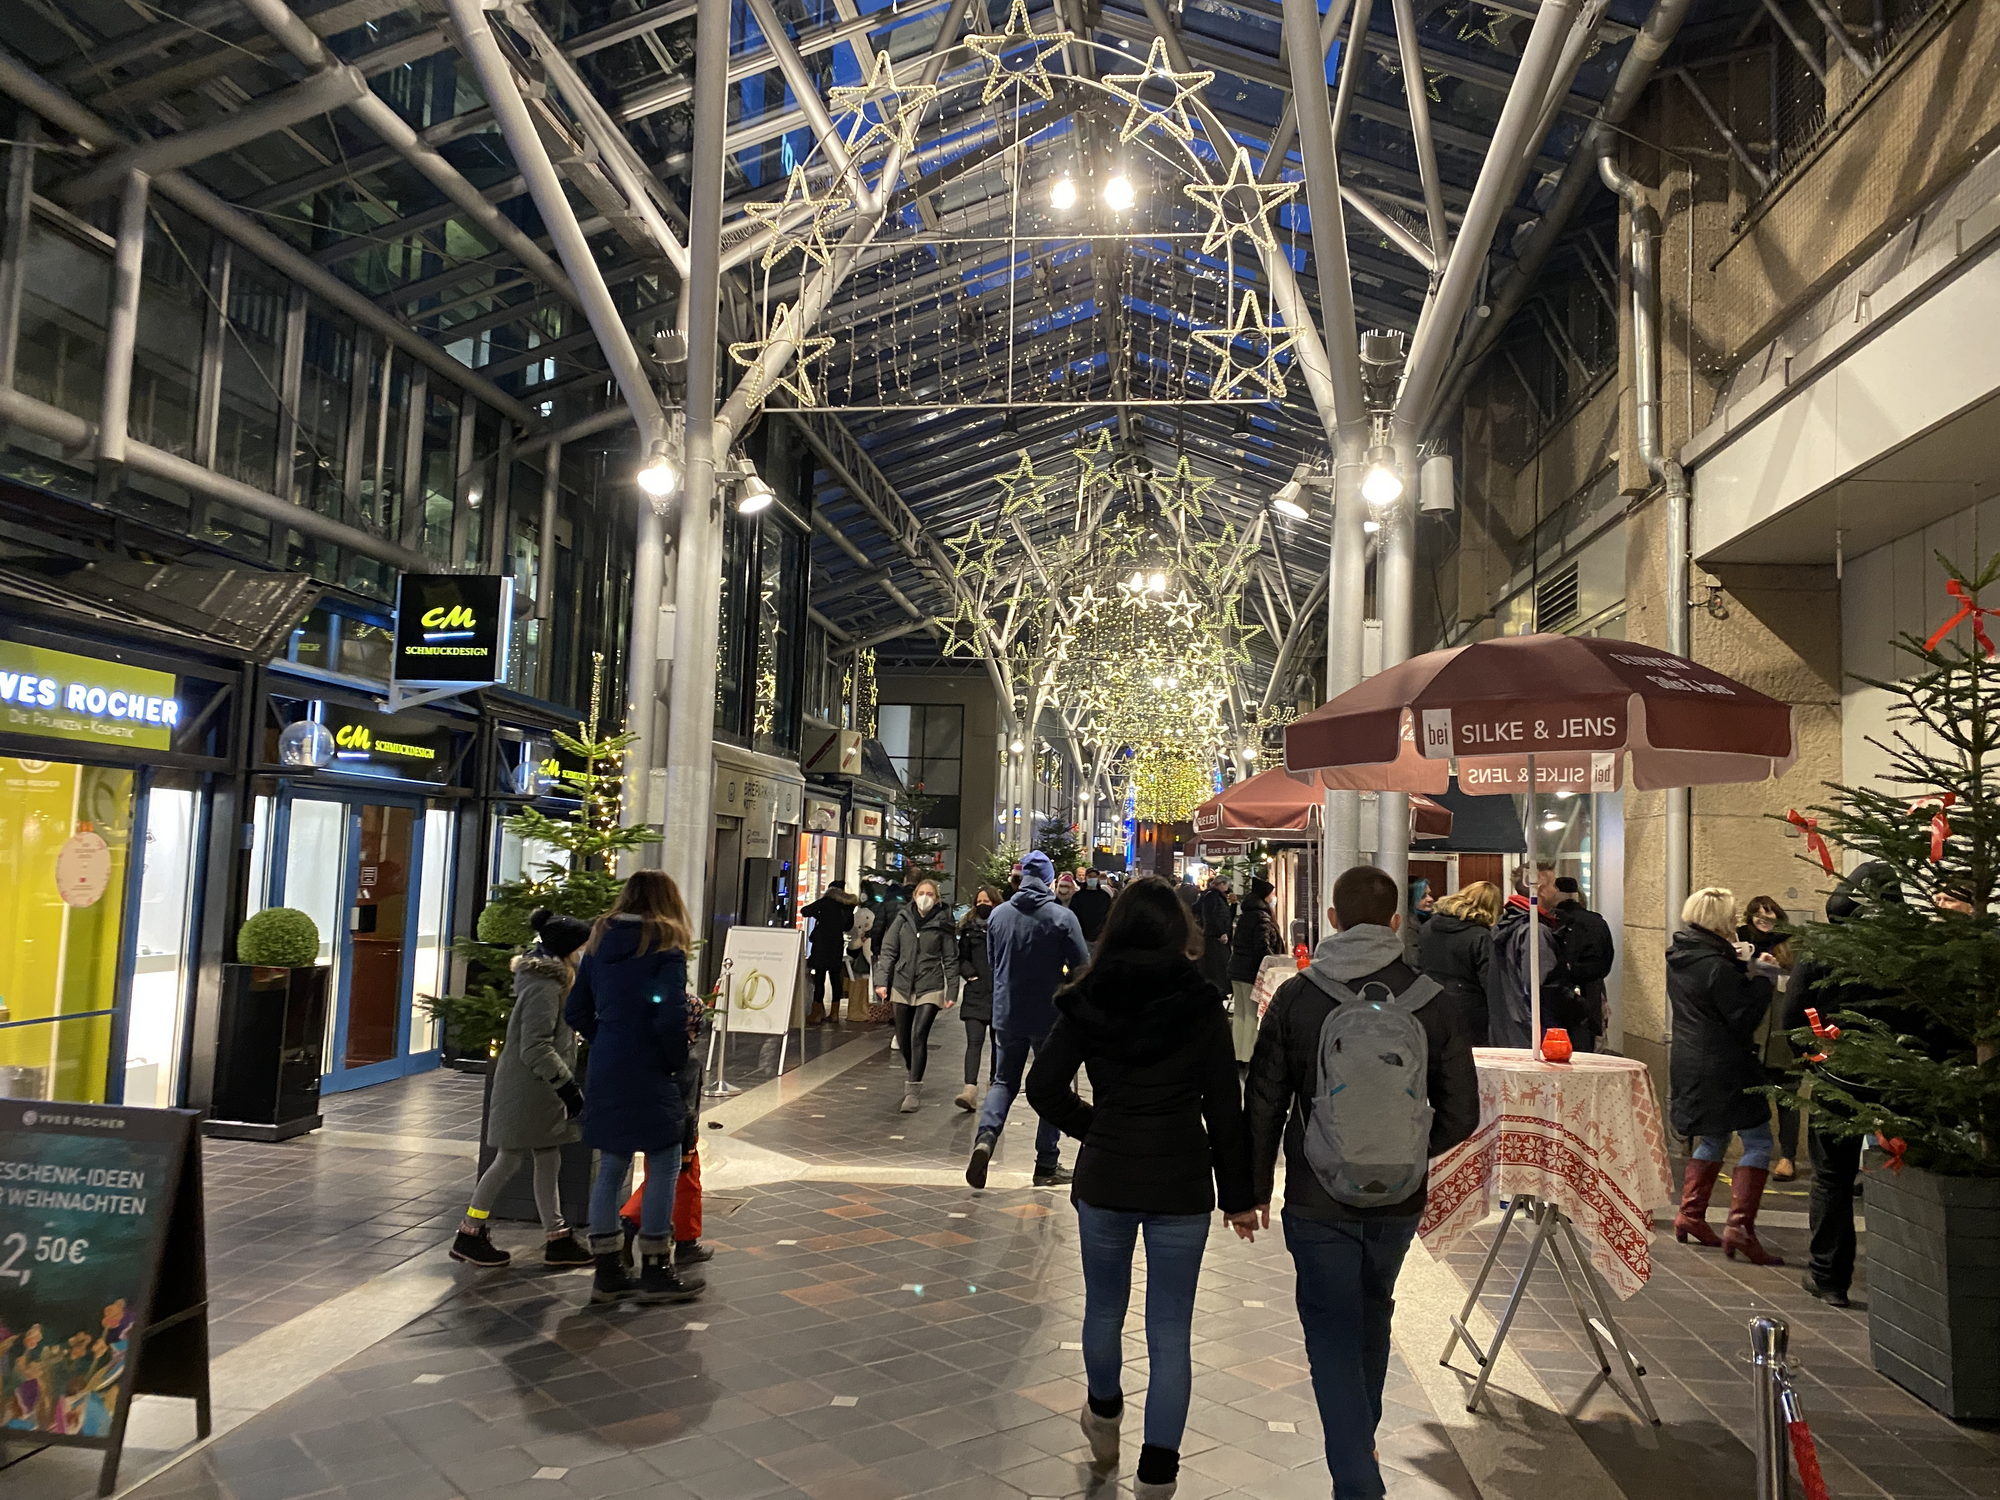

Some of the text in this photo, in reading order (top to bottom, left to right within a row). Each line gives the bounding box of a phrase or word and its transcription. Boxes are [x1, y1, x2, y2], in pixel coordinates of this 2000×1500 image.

[421, 605, 476, 629] CM
[405, 646, 488, 656] SCHMUCKDESIGN
[66, 683, 178, 725] ROCHER
[336, 724, 436, 759] CM SCHMUCKDESIGN
[1428, 722, 1449, 746] bei
[1461, 721, 1524, 744] SILKE
[1533, 720, 1550, 740] &
[1557, 716, 1617, 739] JENS
[39, 1114, 125, 1129] YVES ROCHER
[8, 1187, 147, 1215] WEIHNACHTEN
